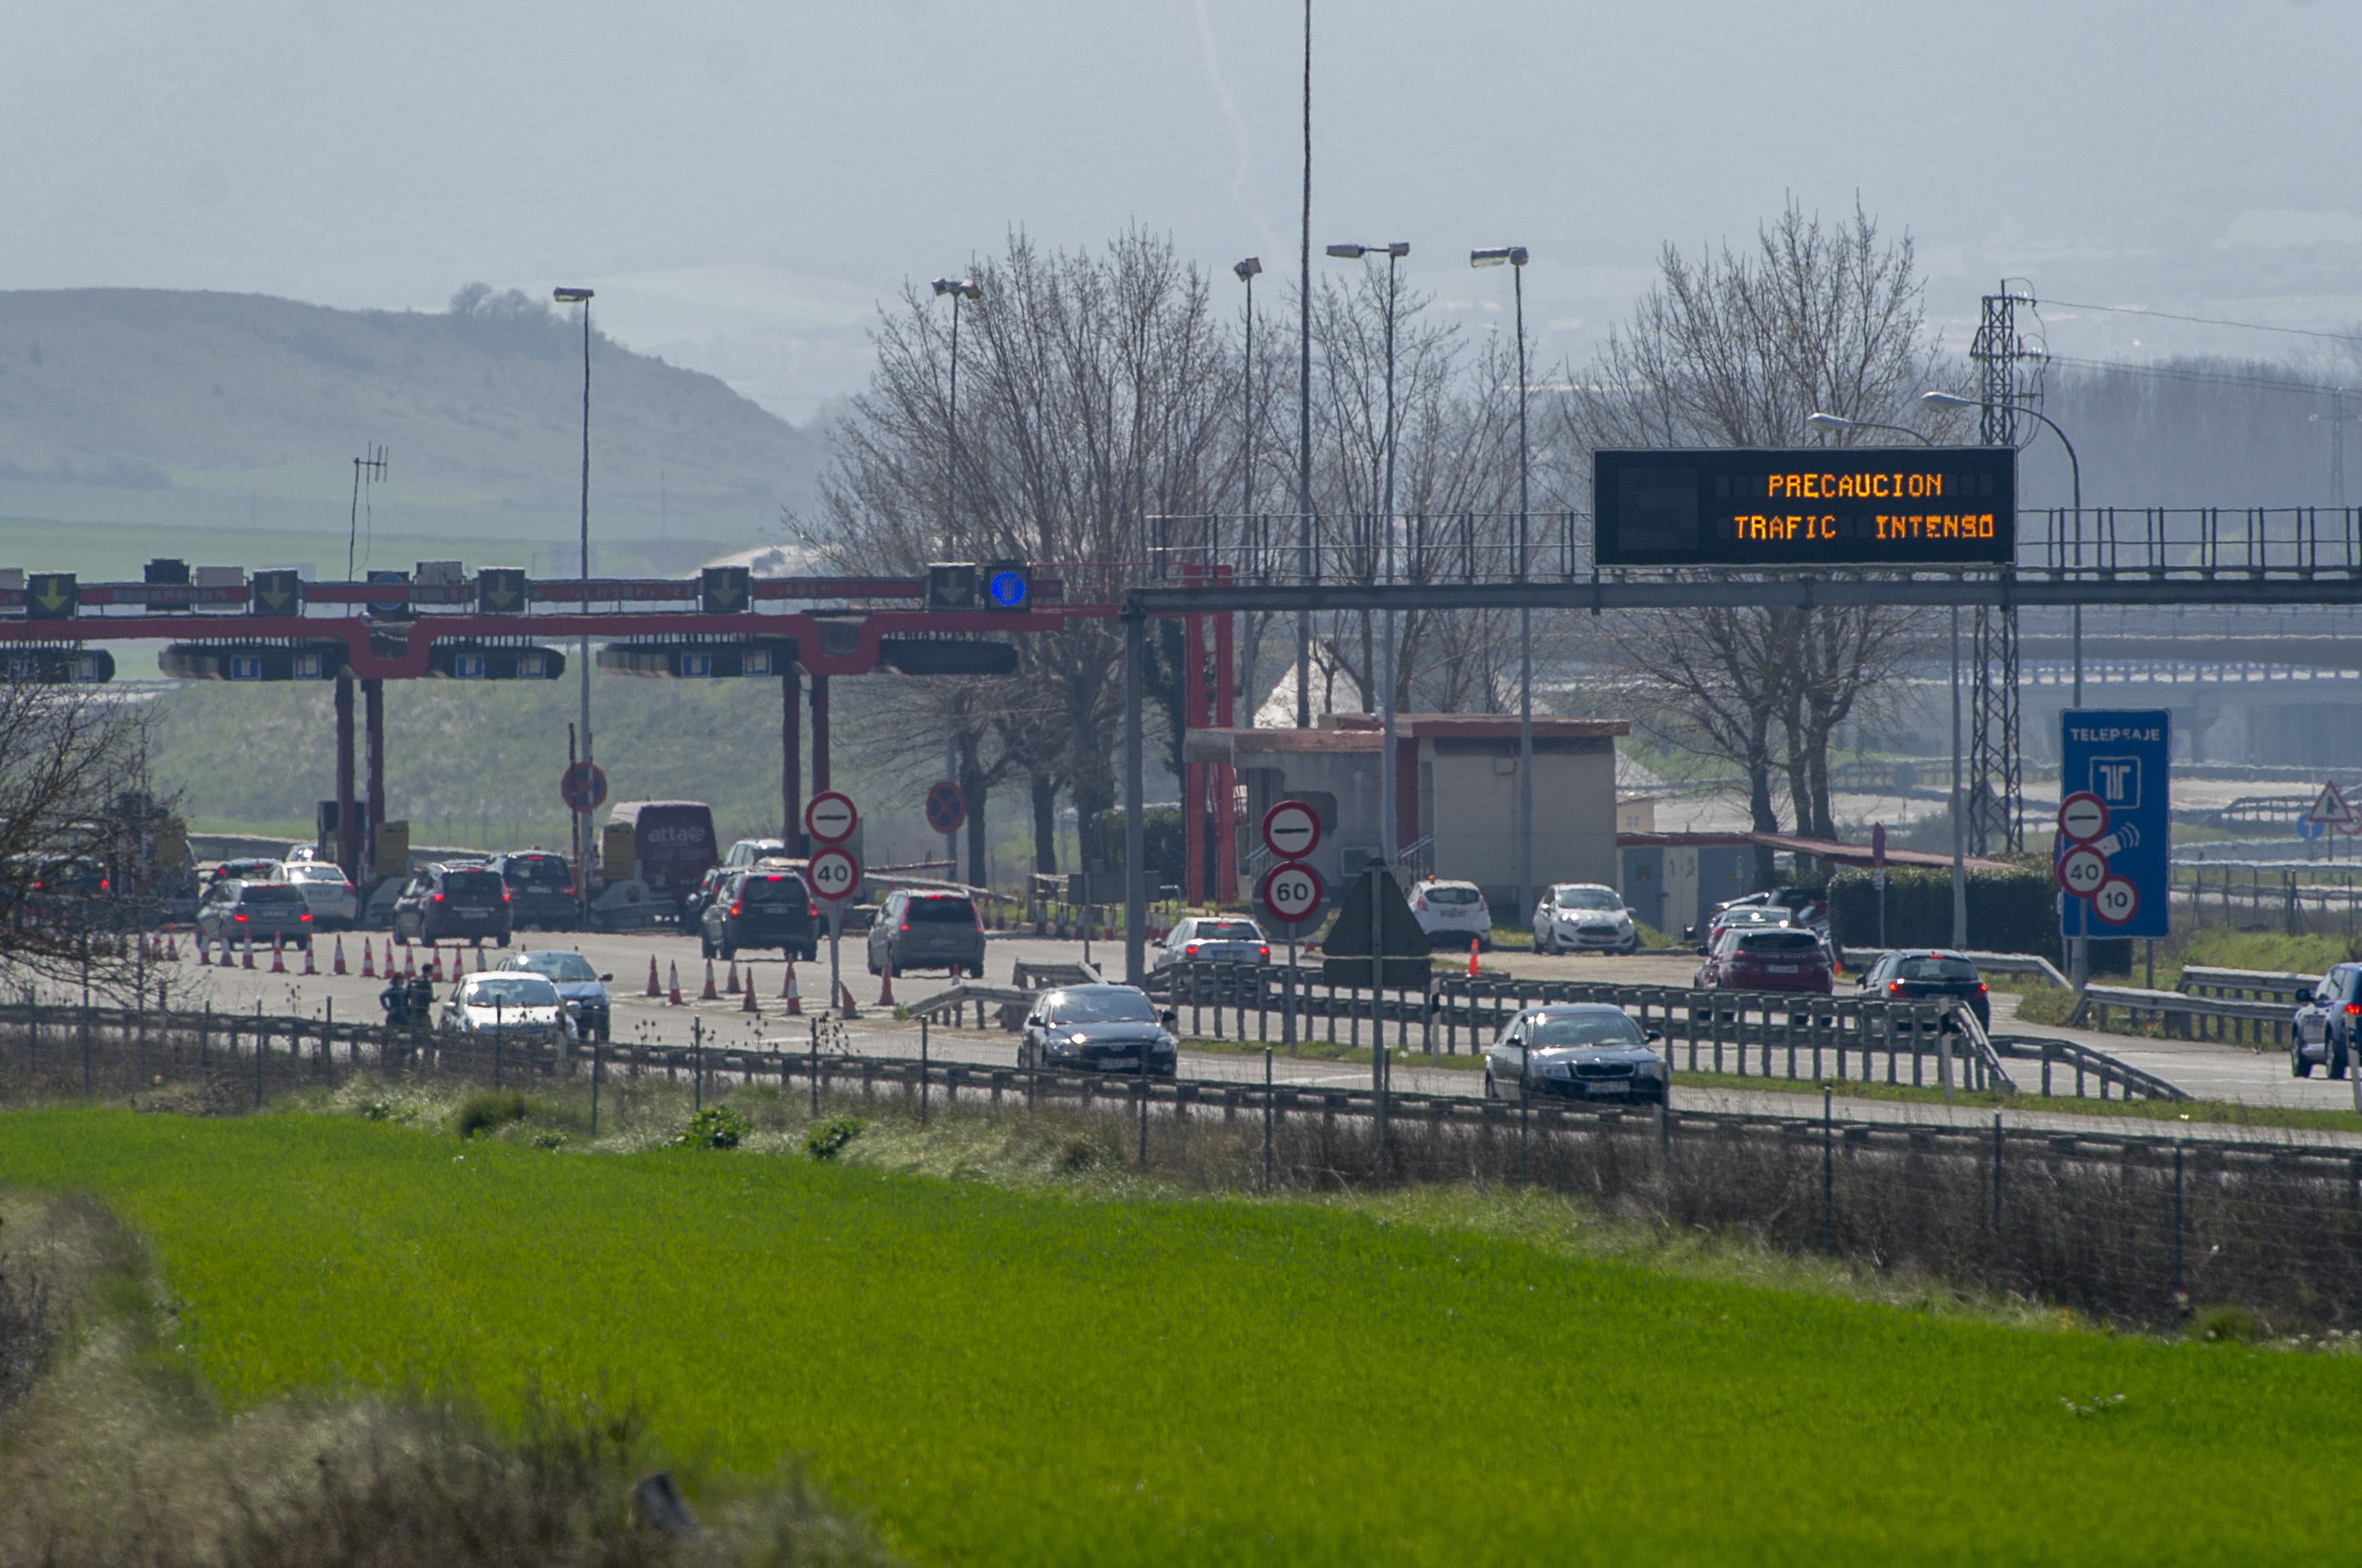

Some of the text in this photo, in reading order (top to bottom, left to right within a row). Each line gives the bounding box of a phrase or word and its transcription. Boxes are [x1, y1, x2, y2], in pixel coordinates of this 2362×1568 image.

[1768, 473, 1942, 499] PRECAUCION
[1735, 513, 1994, 540] TRAFIC INTENSO
[2070, 728, 2161, 742] TELEPEAJE
[817, 865, 848, 882] 40
[2070, 864, 2099, 881] 40
[1277, 883, 1308, 901] 60
[2105, 892, 2128, 909] 10
